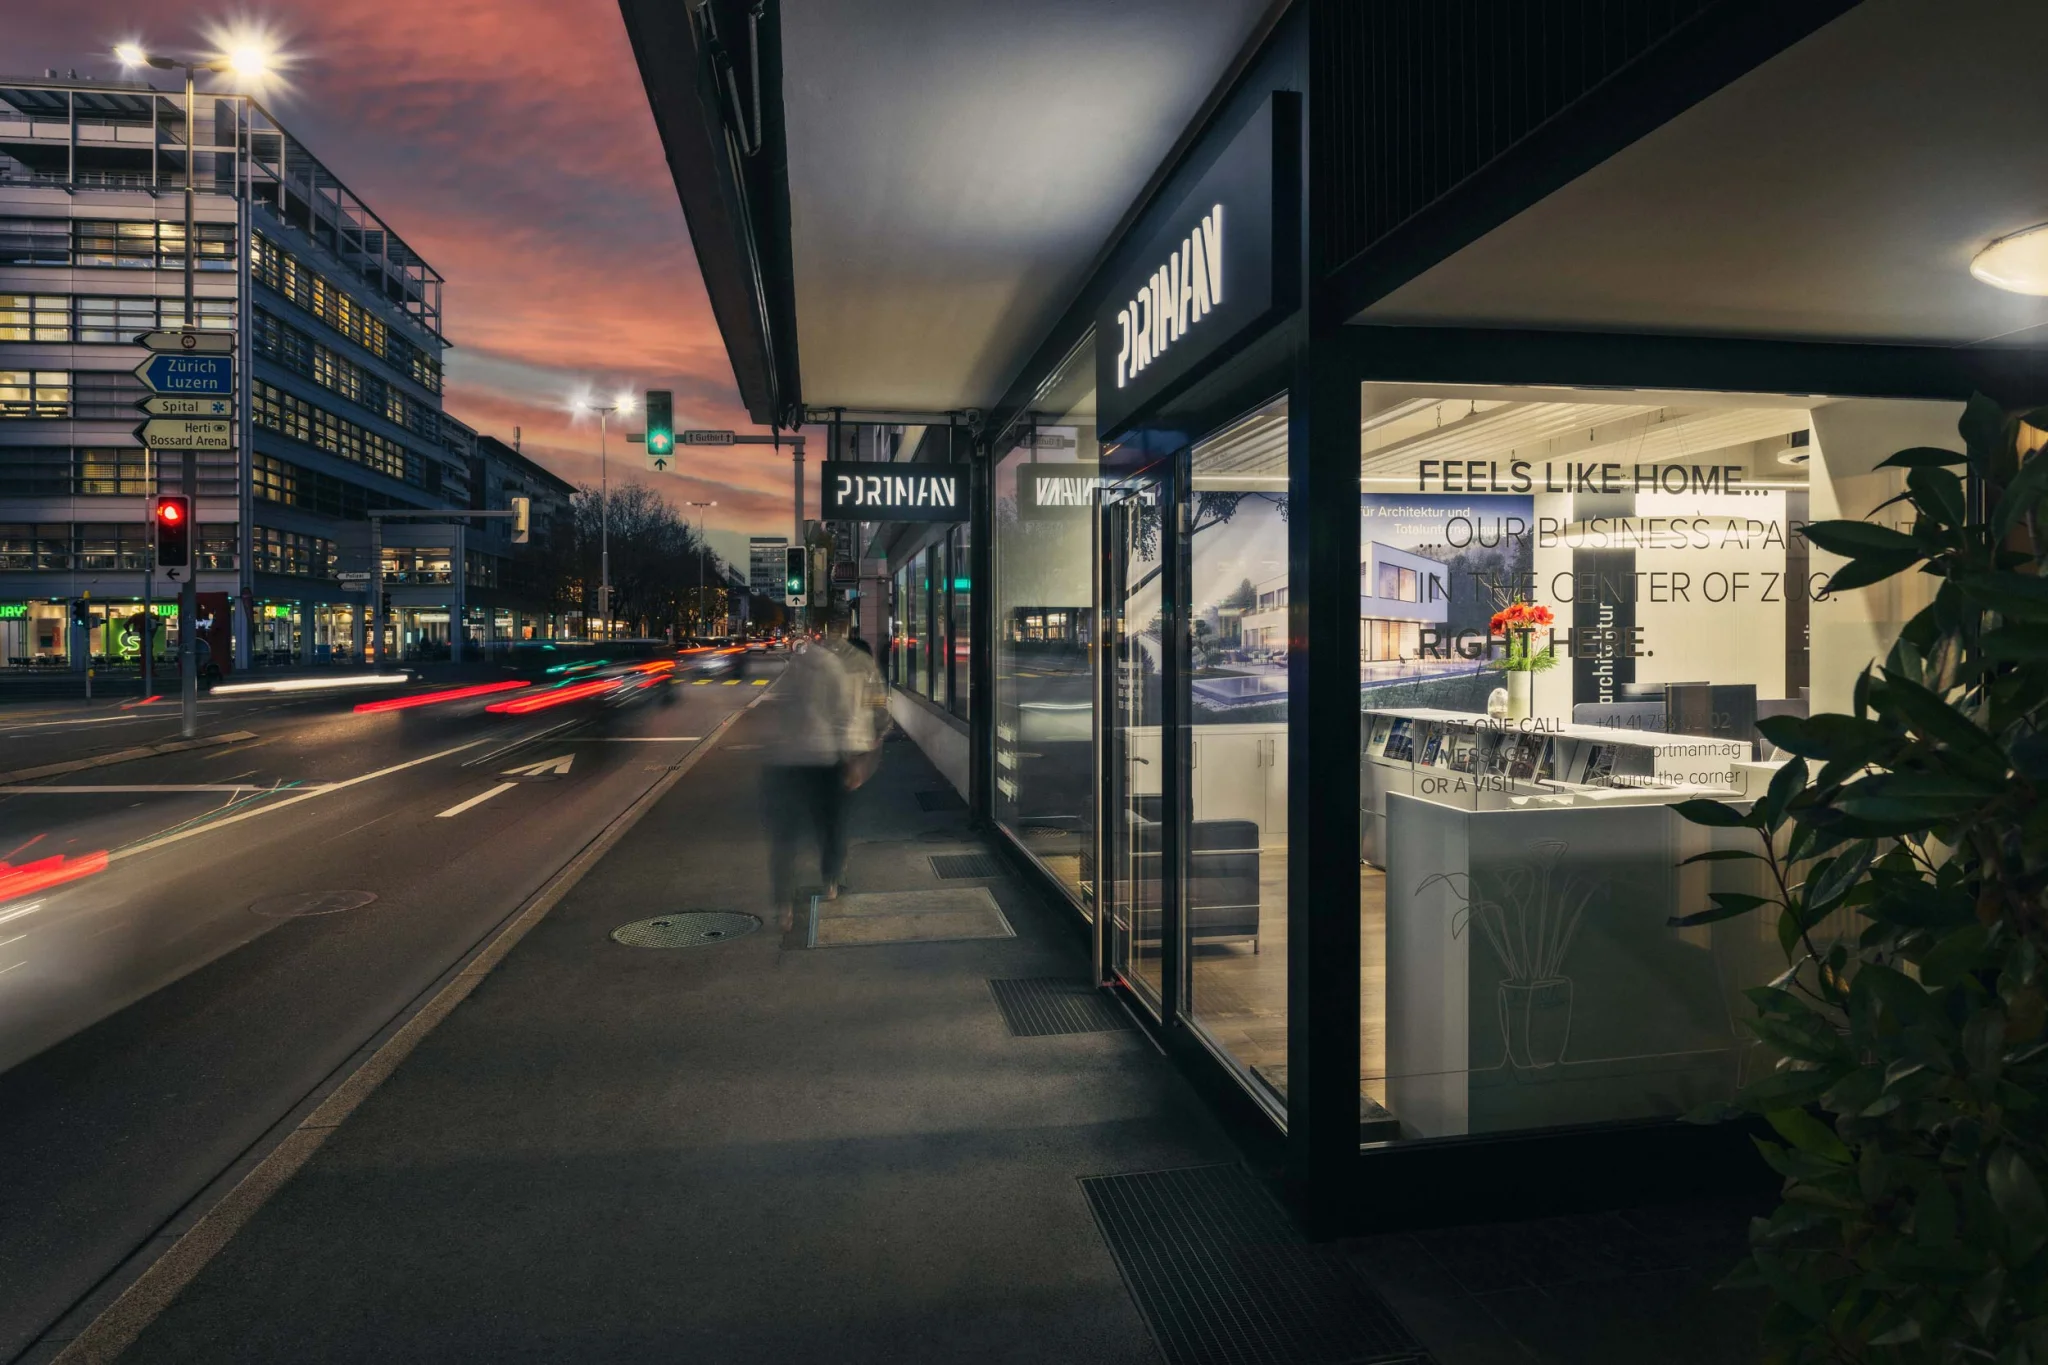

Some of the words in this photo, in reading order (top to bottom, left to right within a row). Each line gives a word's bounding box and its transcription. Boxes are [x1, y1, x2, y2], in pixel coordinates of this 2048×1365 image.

[168, 359, 217, 373] Zürich
[167, 375, 218, 389] Luzern
[162, 401, 199, 414] Spital
[185, 422, 211, 433] Herti
[150, 434, 193, 446] Bossard
[195, 435, 228, 446] Arena
[1419, 460, 1533, 493] FEELS
[1546, 462, 1621, 494] LIKE
[1634, 464, 1769, 497] HOME...
[1361, 505, 1375, 518] ür
[1378, 506, 1445, 518] Architektur
[1448, 507, 1471, 519] und
[1419, 516, 1526, 549] ...OUR
[1539, 517, 1711, 550] BUSINESS
[1720, 519, 1820, 550] APAR
[1420, 572, 1452, 604] IN
[1467, 572, 1538, 603] THE
[1551, 571, 1691, 604] CENTER
[1703, 571, 1750, 603] OF
[1760, 571, 1838, 603] ZUG.
[1419, 627, 1536, 660] RIGHT
[1549, 627, 1654, 659] HERE.
[1474, 717, 1514, 734] ONE
[1519, 716, 1566, 734] CALL
[1595, 714, 1621, 731] +41
[1626, 714, 1642, 731] 41
[1710, 711, 1732, 729] 02
[1420, 777, 1449, 794] OR
[1453, 776, 1468, 793] A
[1473, 775, 1516, 792] VISIT
[1595, 771, 1653, 788] around
[1658, 769, 1684, 787] the
[1689, 770, 1741, 785] corner
